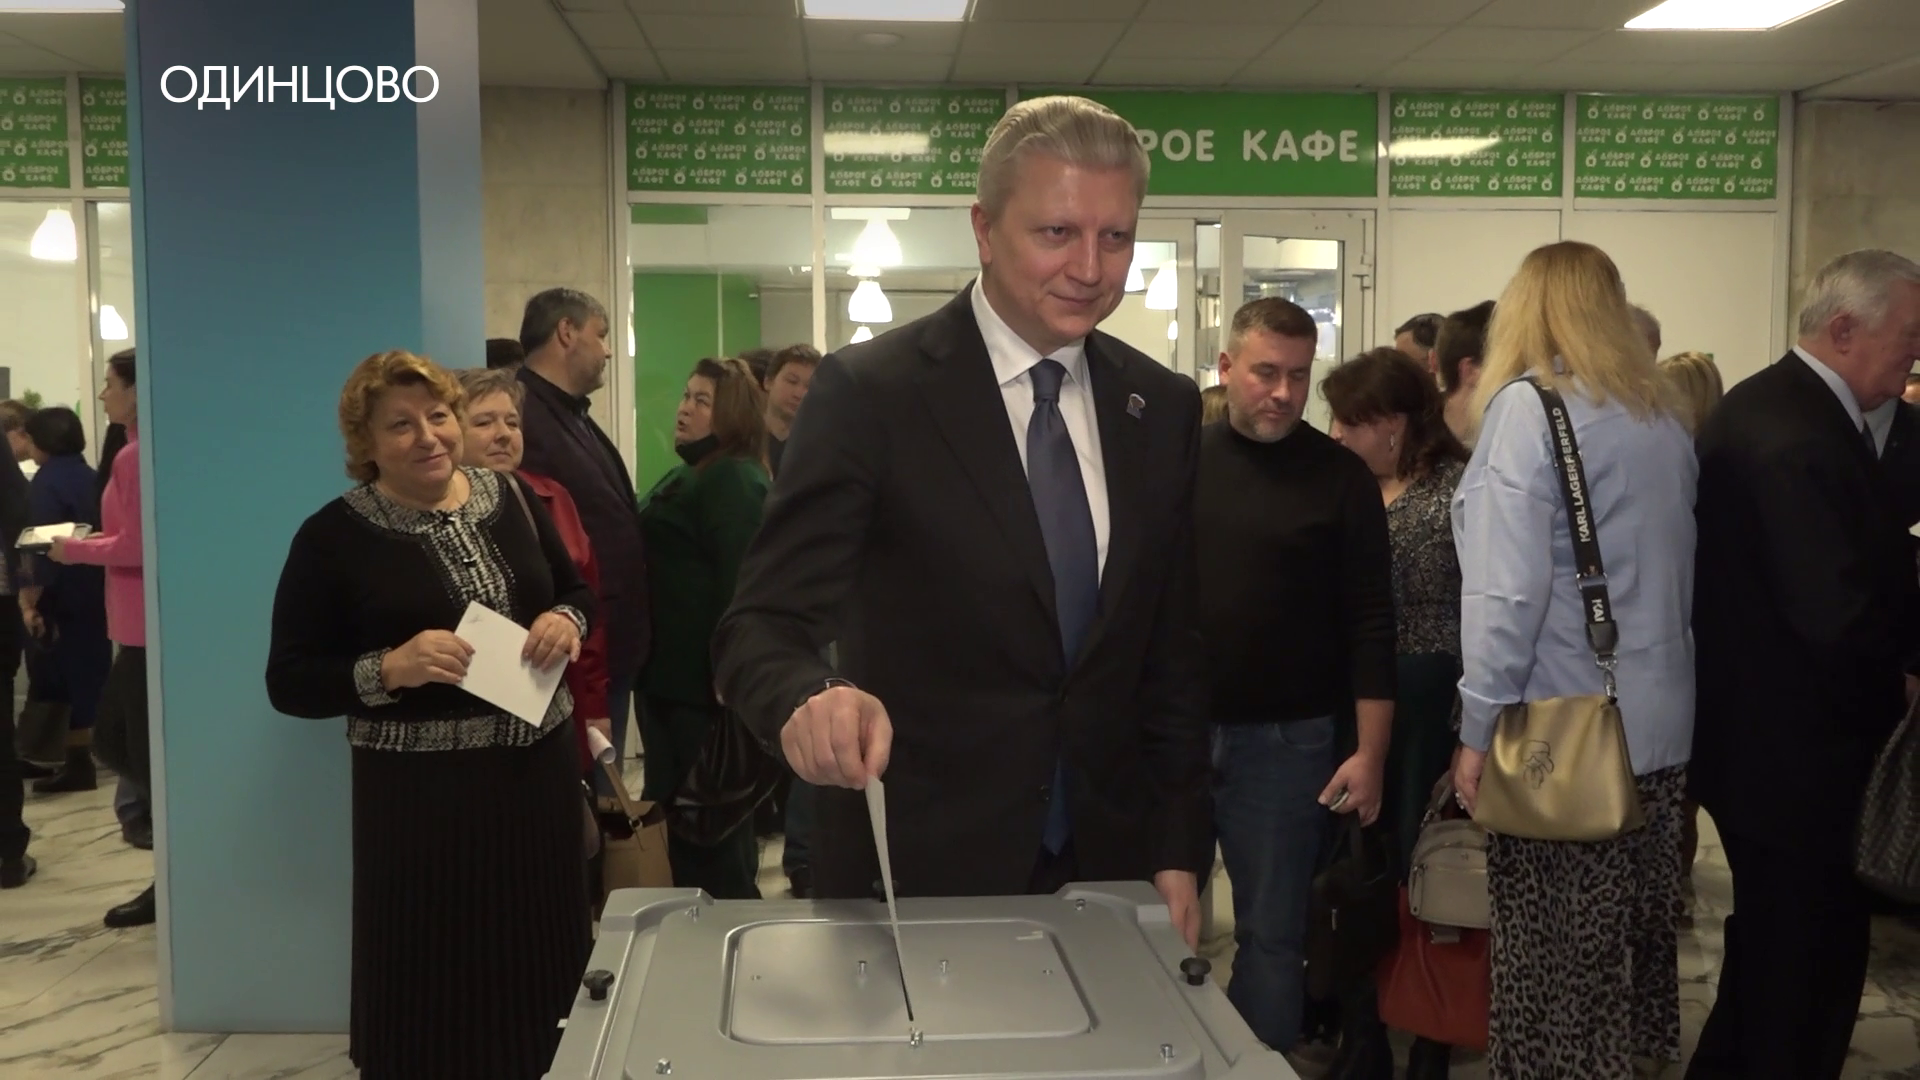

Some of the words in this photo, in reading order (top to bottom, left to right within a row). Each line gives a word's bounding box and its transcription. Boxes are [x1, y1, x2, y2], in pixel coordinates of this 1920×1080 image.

[1136, 129, 1215, 161] РОЕ
[1243, 129, 1358, 162] КАФЕ
[1576, 506, 1591, 542] KARL
